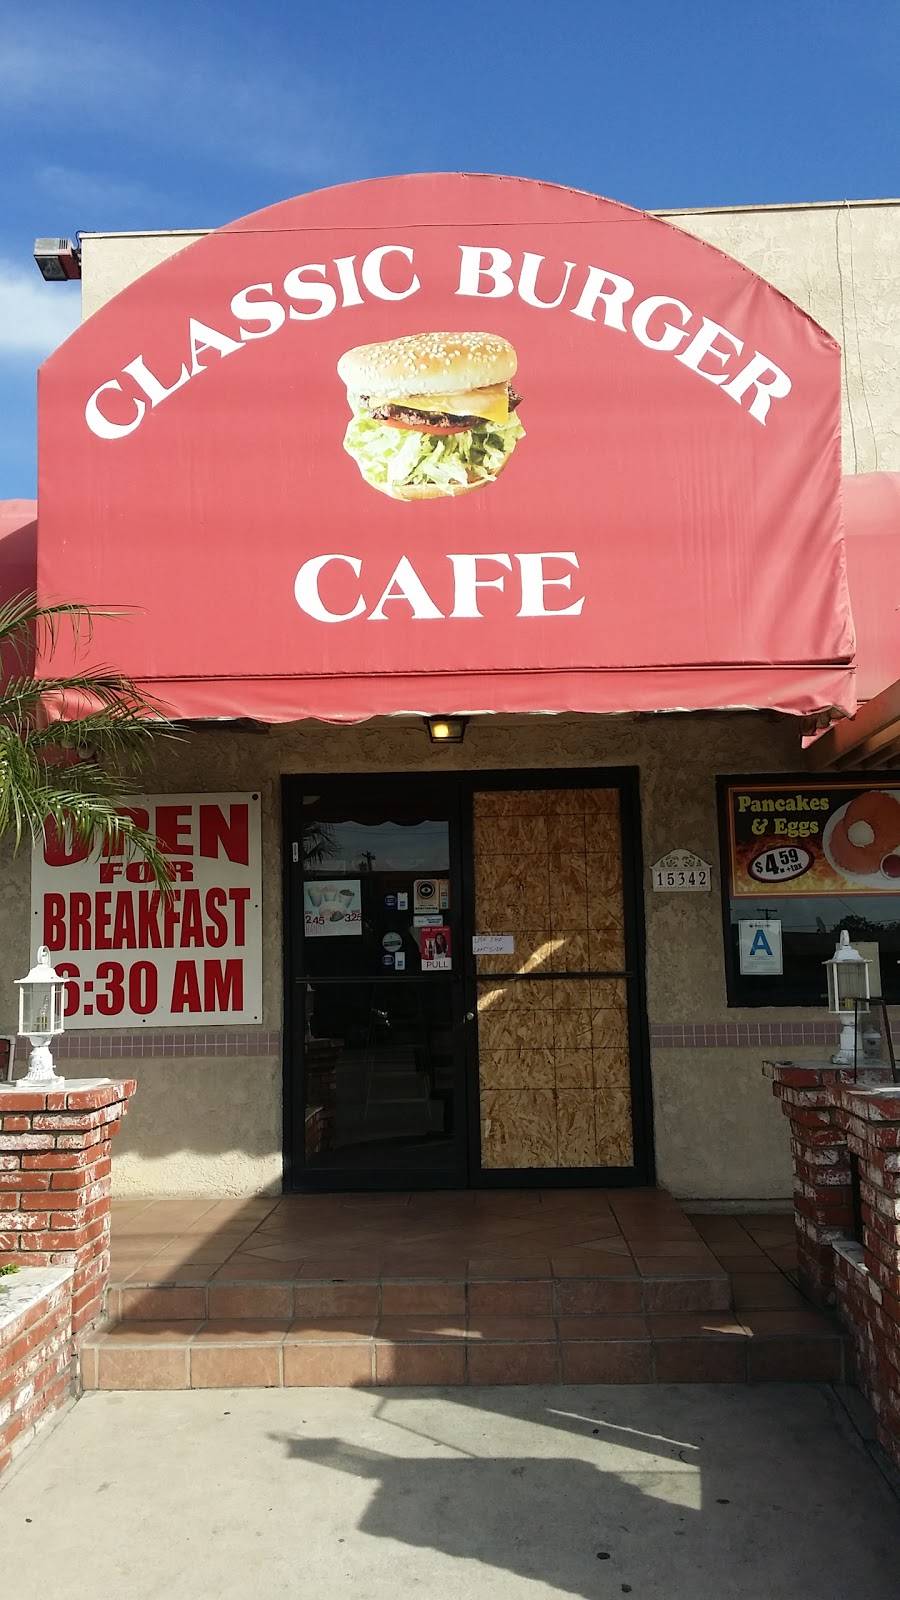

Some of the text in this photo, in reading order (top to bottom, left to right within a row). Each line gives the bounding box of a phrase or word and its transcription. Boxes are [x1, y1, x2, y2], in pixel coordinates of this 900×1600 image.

[84, 245, 793, 440] CLASSIC BURGER
[294, 551, 586, 623] CAFE
[737, 794, 830, 812] Pancakes
[751, 818, 819, 837] & Eggs
[99, 860, 194, 884] FOR
[656, 871, 707, 886] 15342
[43, 887, 251, 952] BREAKFAST
[750, 929, 773, 955] A
[170, 959, 244, 1013] AM
